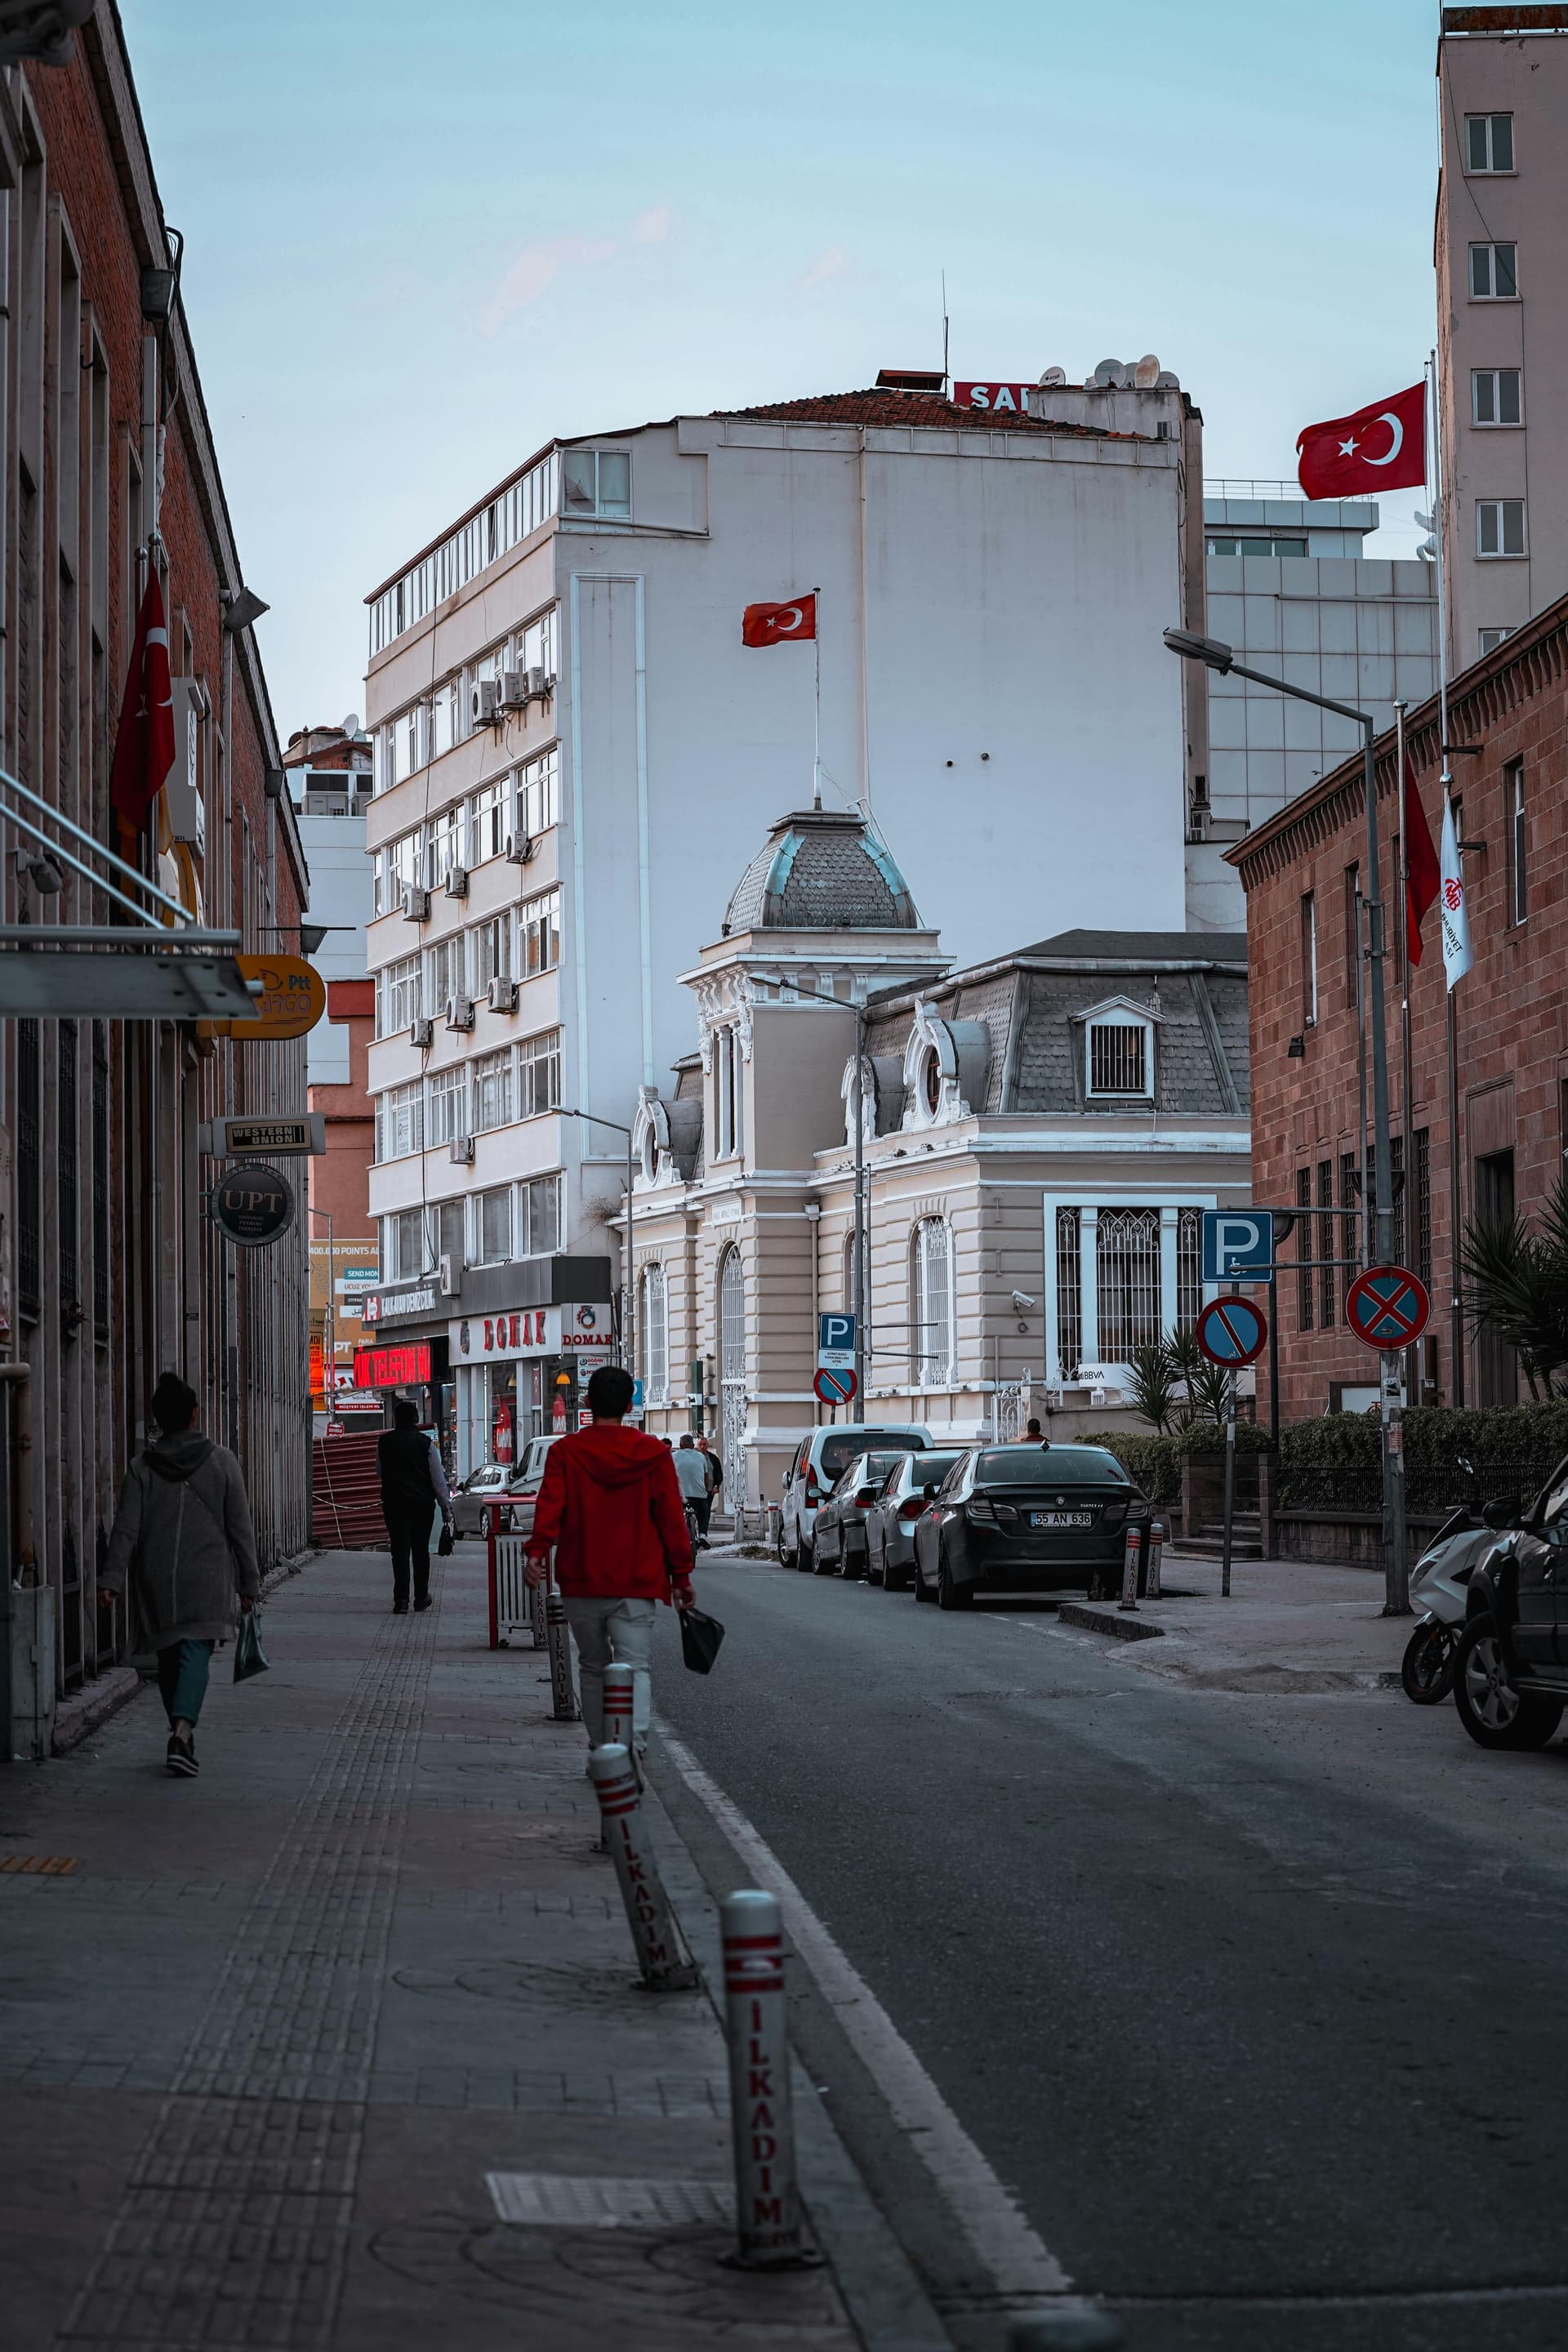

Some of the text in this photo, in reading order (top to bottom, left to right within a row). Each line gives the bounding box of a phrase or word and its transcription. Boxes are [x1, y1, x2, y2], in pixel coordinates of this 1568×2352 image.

[261, 993, 311, 1013] ARGO
[233, 1127, 292, 1138] WESTERN
[252, 1135, 293, 1145] UNION
[224, 1189, 282, 1214] UPT
[341, 1247, 368, 1255] POINTS
[1216, 1218, 1259, 1275] P
[483, 1311, 547, 1352] DOMAK
[827, 1318, 848, 1346] P
[563, 1334, 613, 1346] DOMAK
[372, 1346, 416, 1386] TELEFON
[1085, 1370, 1105, 1380] BBVA
[1036, 1513, 1090, 1523] 55 AN 636
